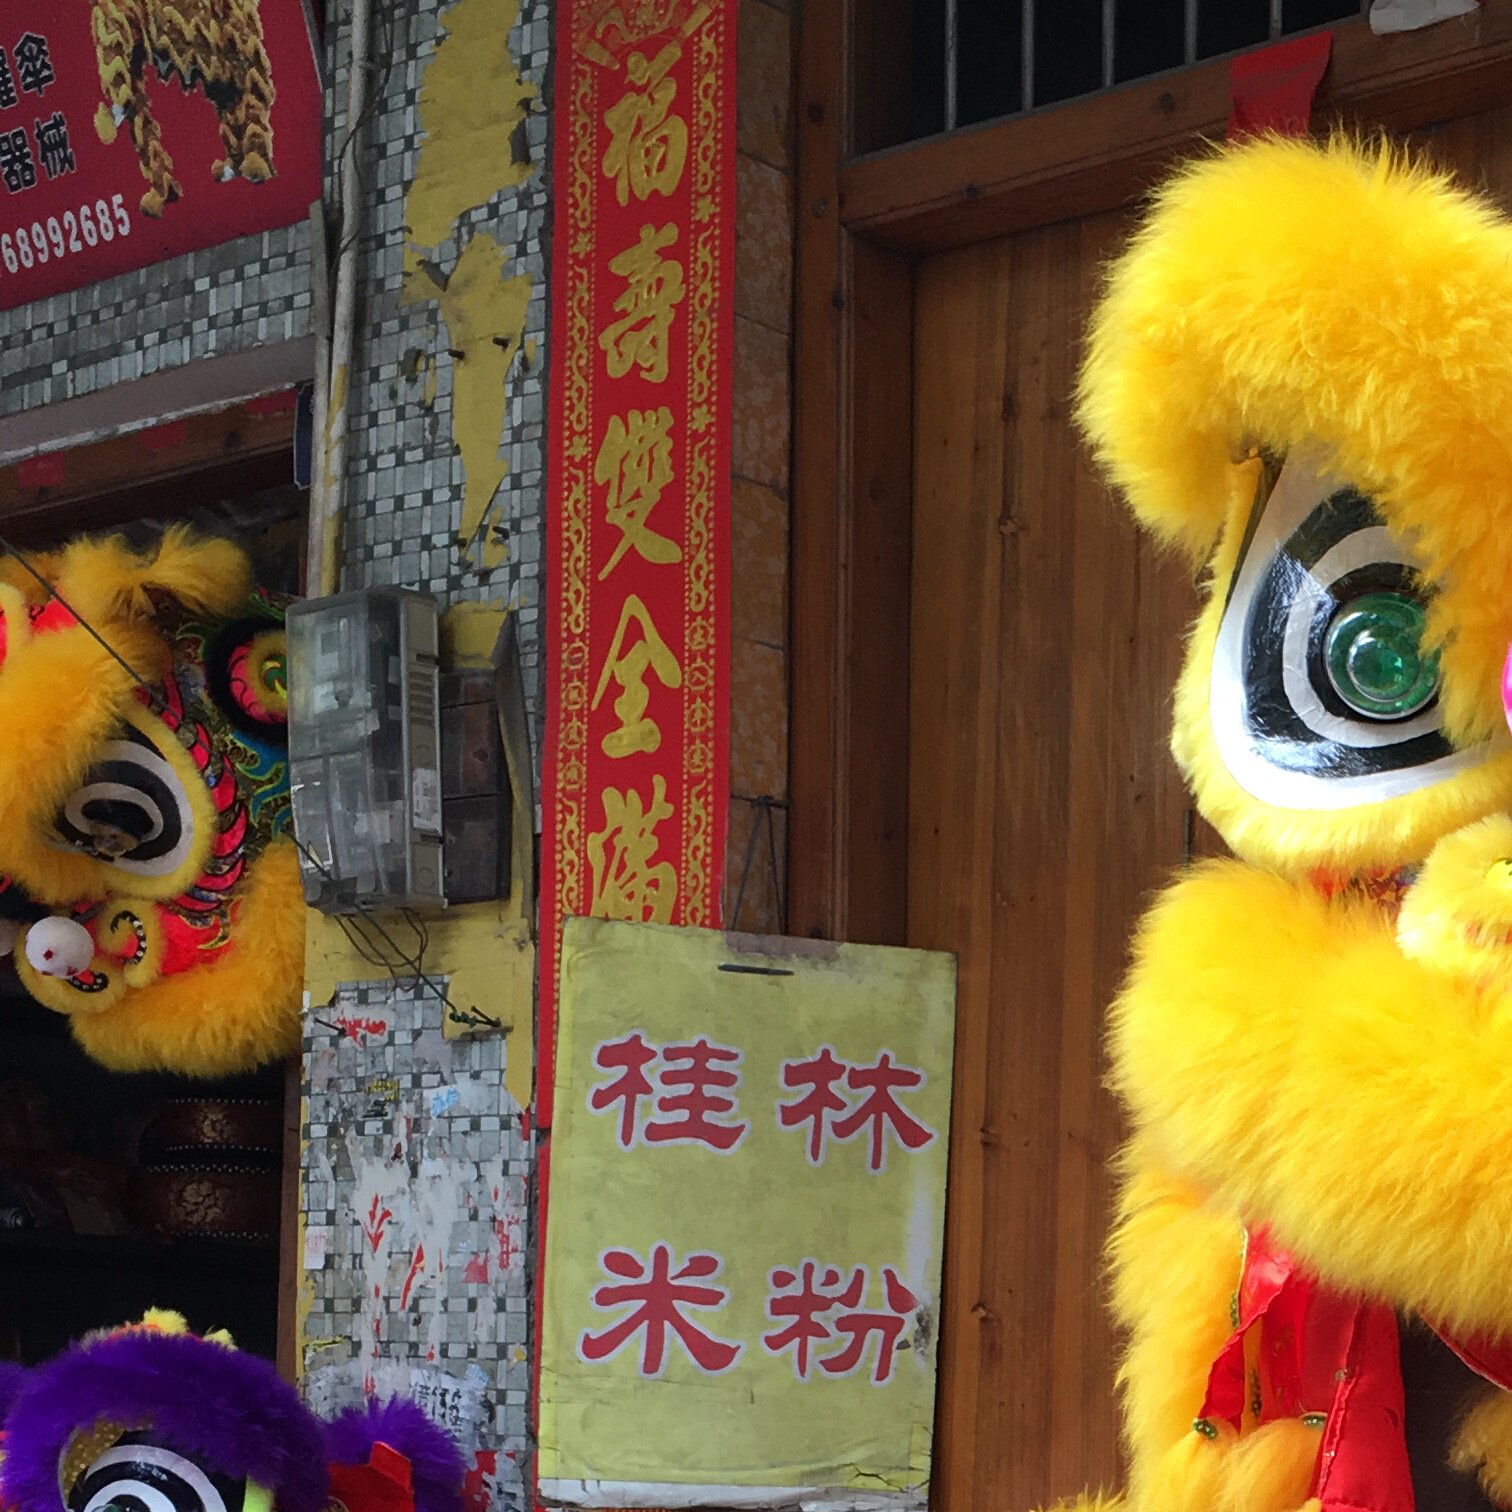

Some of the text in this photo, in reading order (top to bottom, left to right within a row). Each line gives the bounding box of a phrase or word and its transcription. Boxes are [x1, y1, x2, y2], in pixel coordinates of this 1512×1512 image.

[0, 111, 76, 194] 器械
[1, 193, 130, 273] 68992685
[588, 1029, 936, 1174] 桂林
[578, 1242, 921, 1386] 米粉
